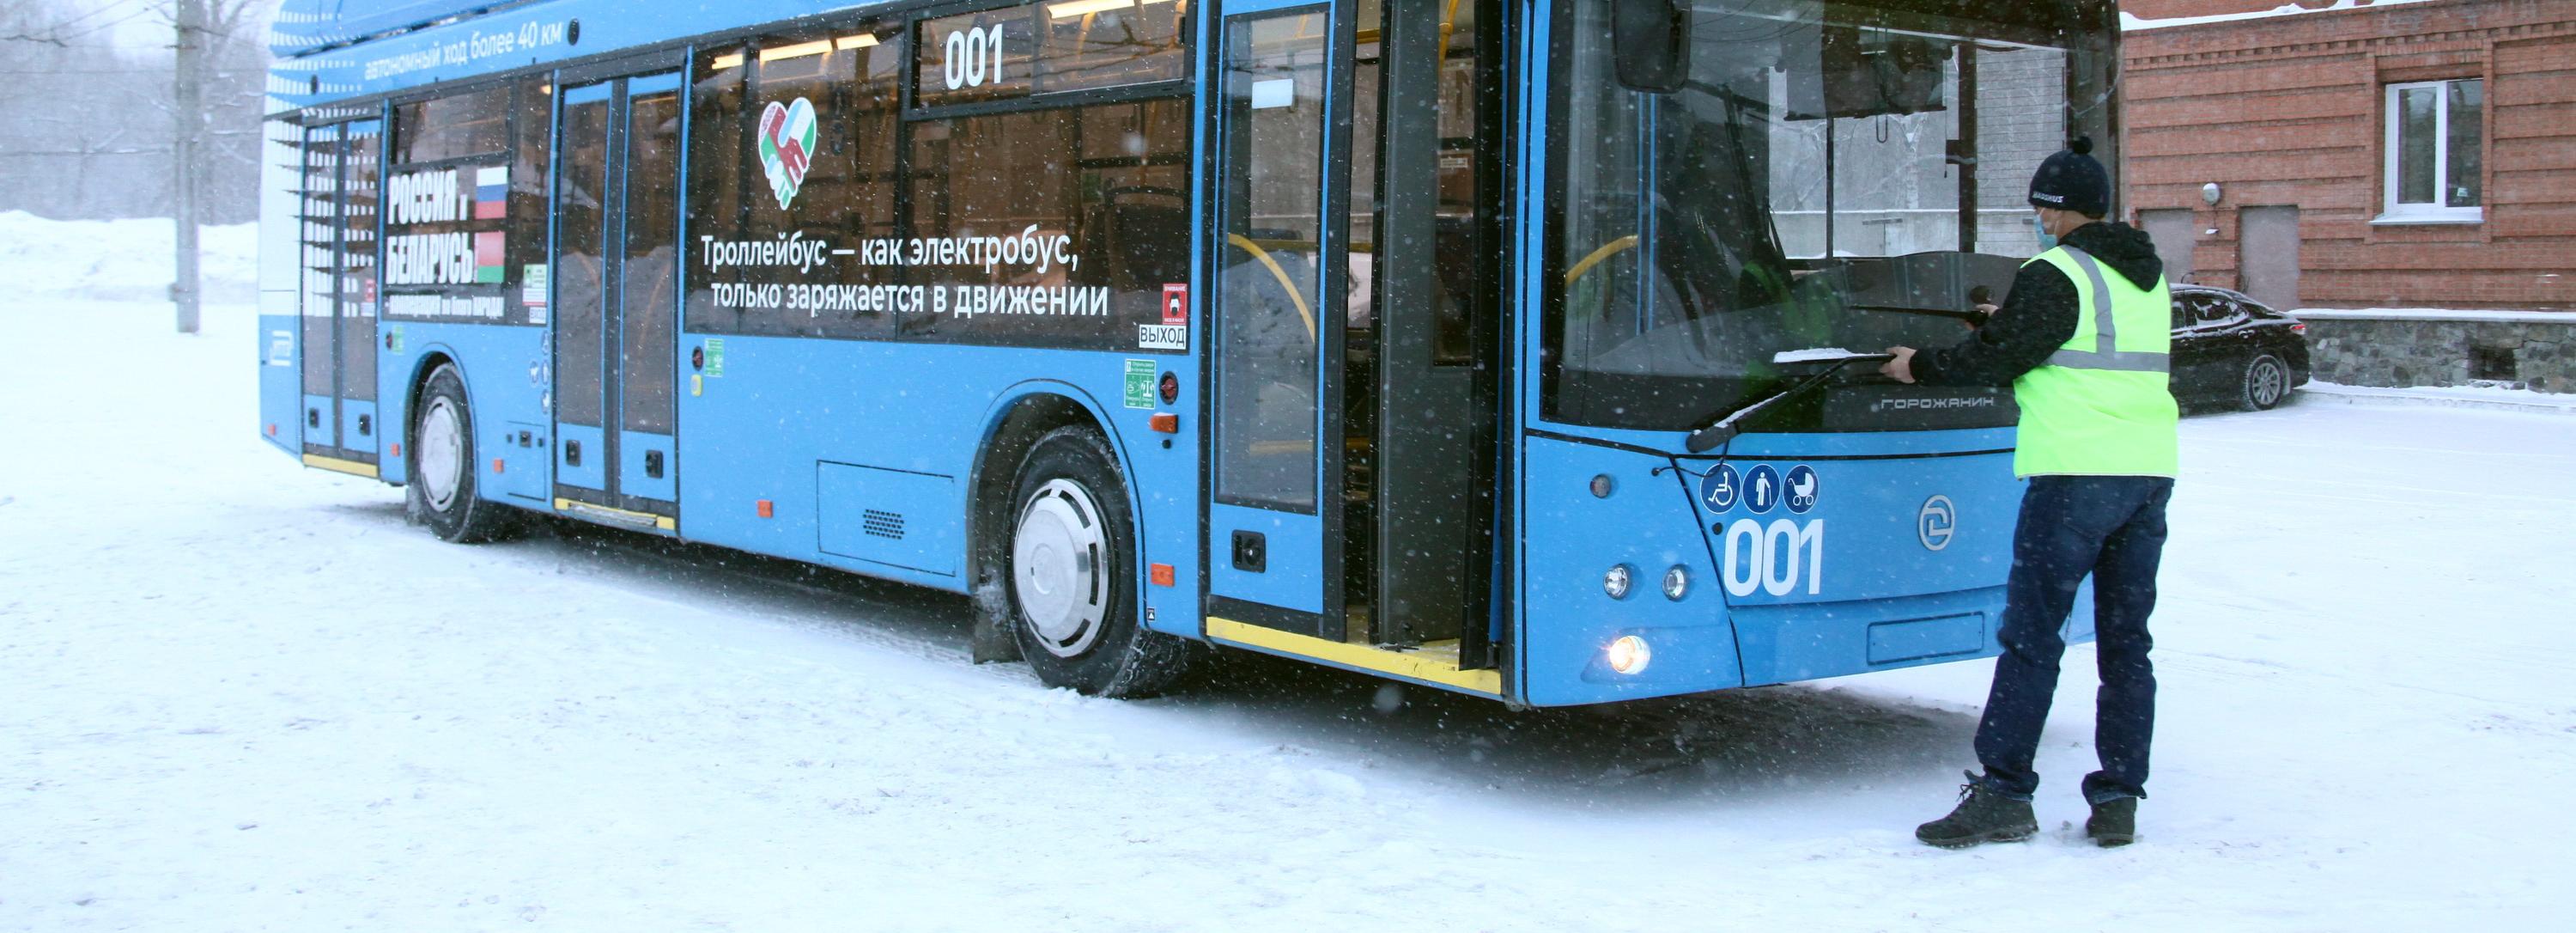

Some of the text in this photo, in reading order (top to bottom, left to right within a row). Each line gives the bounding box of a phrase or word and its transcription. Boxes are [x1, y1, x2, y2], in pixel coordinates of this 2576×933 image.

[364, 21, 562, 81] автономный ход более 40 км
[945, 23, 1003, 90] 001
[388, 169, 457, 224] РОССИЯ
[386, 232, 474, 284] БЕЛАРУСЬ
[701, 230, 827, 274] Троллейбус
[861, 238, 903, 265] как
[910, 223, 1078, 274] электробус,
[711, 283, 1109, 319] только заряжается в движении
[1139, 327, 1186, 347] ВЫХОД
[1881, 397, 1994, 410] ГОРОЖАНИН
[1723, 518, 1824, 597] 001
